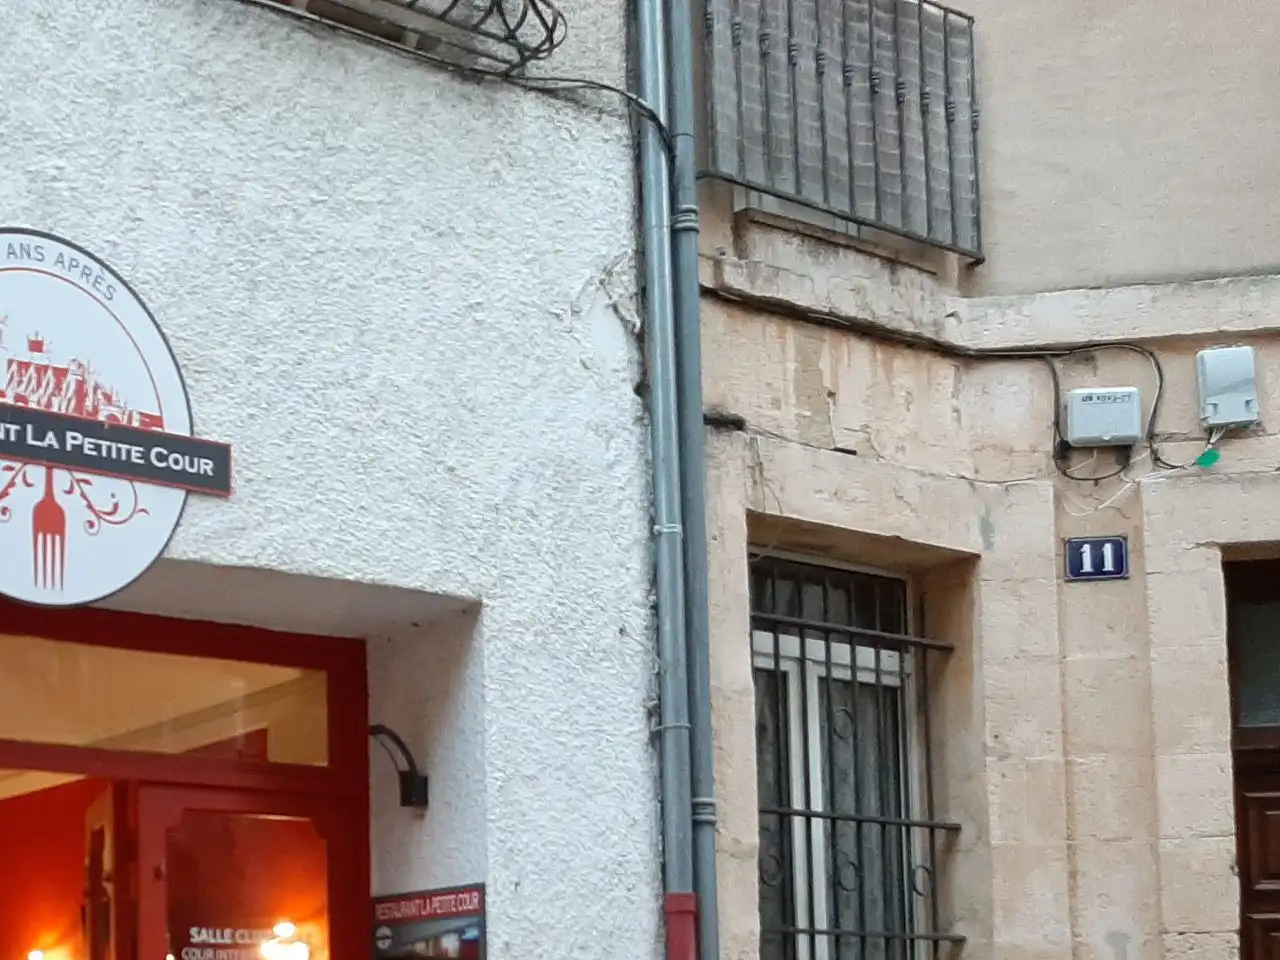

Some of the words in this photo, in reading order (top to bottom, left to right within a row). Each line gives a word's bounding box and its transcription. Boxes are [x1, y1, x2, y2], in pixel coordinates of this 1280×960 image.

[6, 242, 46, 262] ANS
[53, 250, 118, 302] APRÈS
[24, 423, 60, 451] LA
[65, 430, 146, 466] PETITE
[149, 446, 215, 477] COUR
[1078, 542, 1115, 573] 11
[188, 926, 234, 944] SALLE
